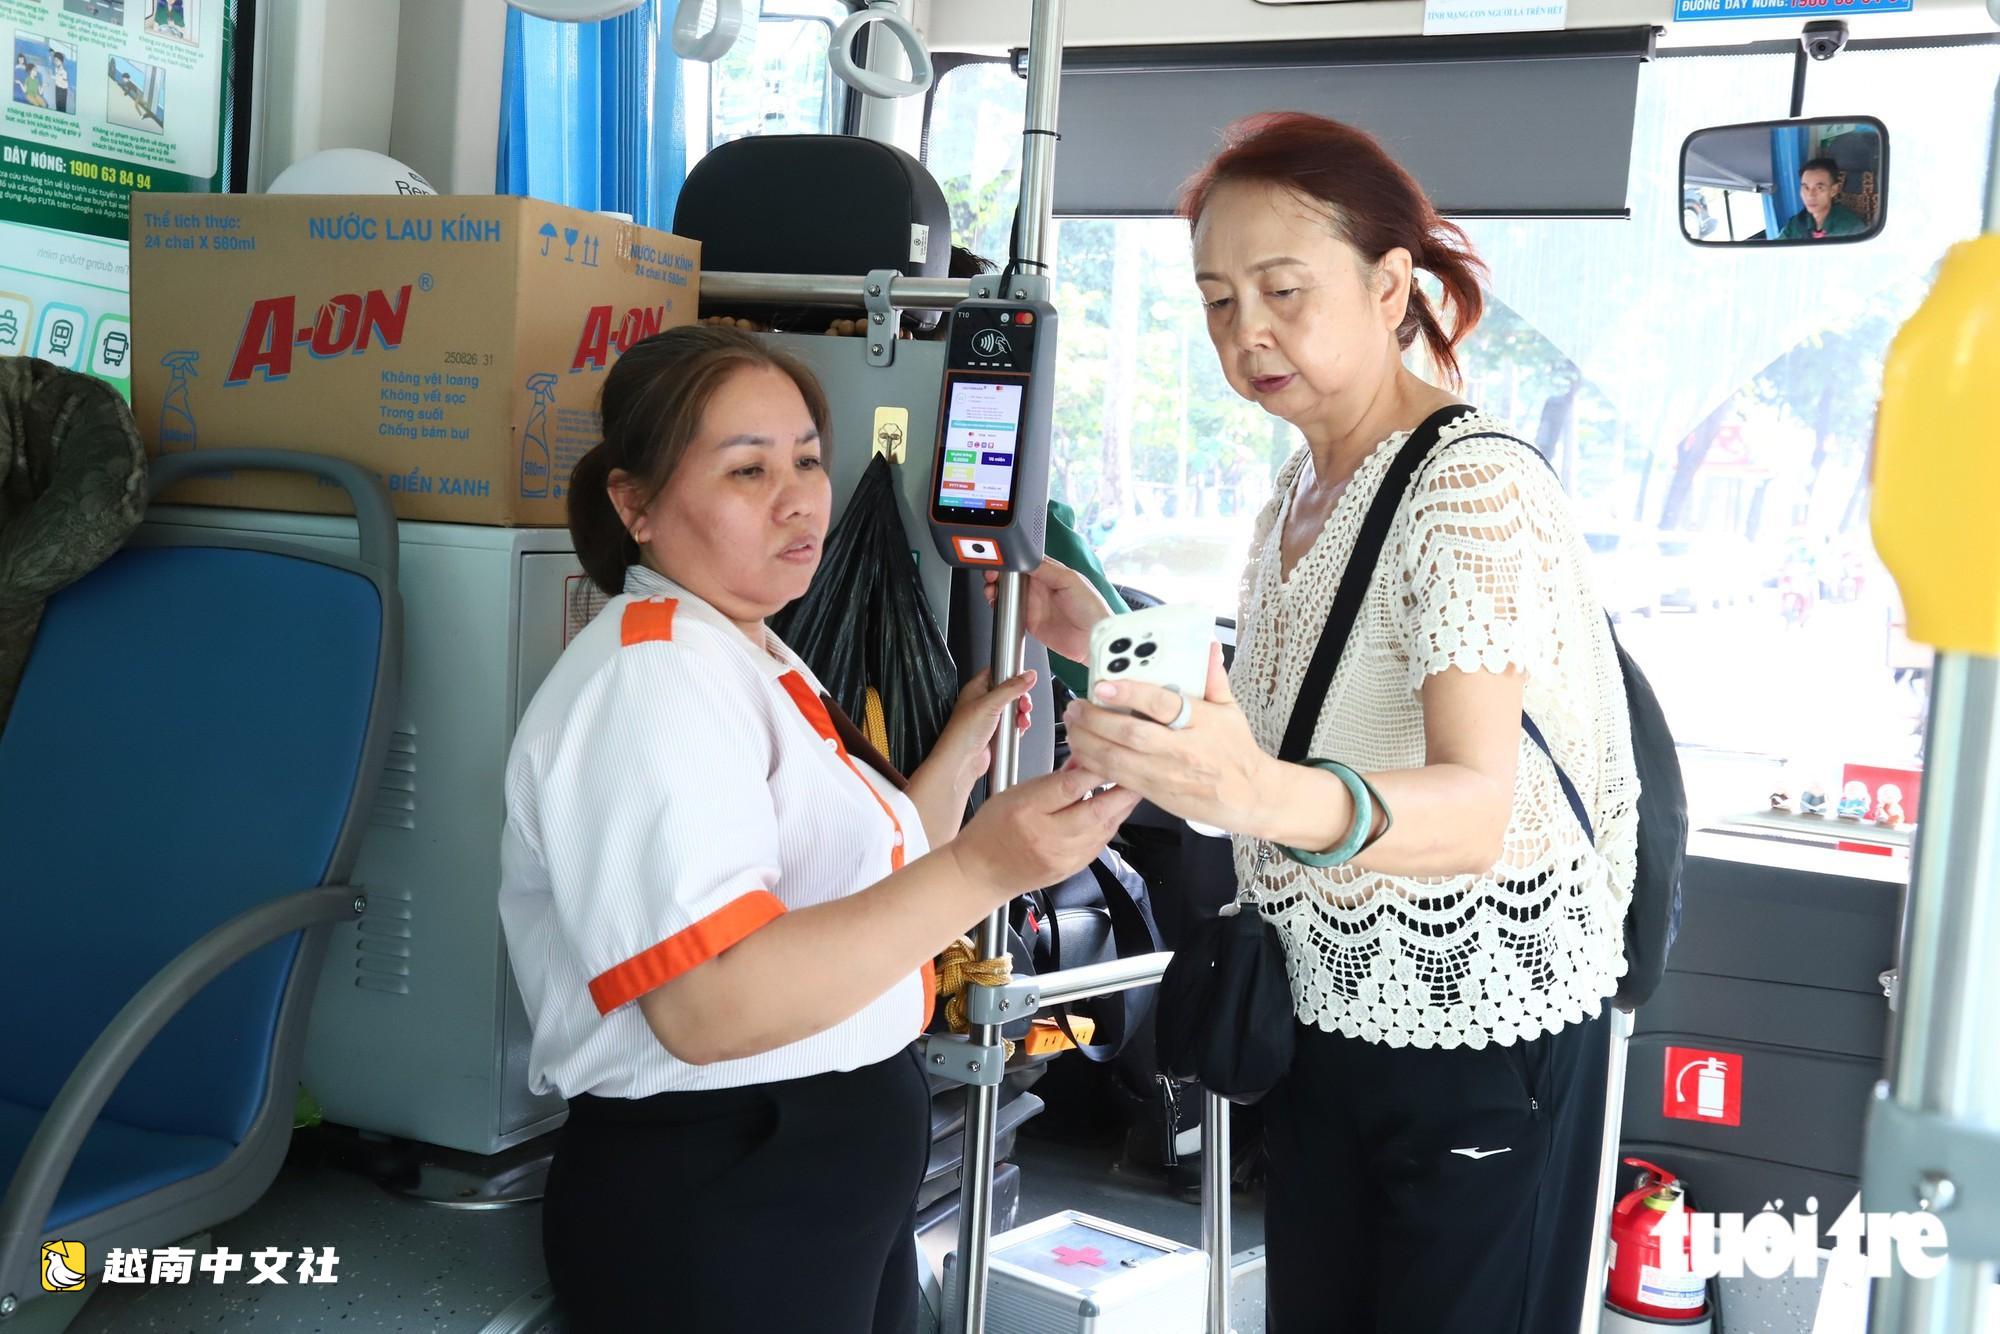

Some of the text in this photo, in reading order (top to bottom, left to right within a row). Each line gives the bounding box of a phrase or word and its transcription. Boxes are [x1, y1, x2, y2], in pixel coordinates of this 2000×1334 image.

[3, 145, 151, 190] DÂY NÓNG: 1900 63 84 94
[38, 197, 55, 207] FUTA
[72, 203, 93, 215] Google
[144, 209, 170, 229] Thể
[308, 211, 501, 242] NƯỚC LAU KÍNH
[144, 235, 161, 249] 24
[165, 235, 194, 249] chai
[658, 250, 673, 268] LAU
[957, 311, 970, 319] T10
[223, 284, 414, 389] A-ON
[444, 351, 494, 366] 250826 31
[381, 369, 420, 386] Không
[446, 373, 480, 389] loang
[381, 388, 419, 405] Không
[379, 405, 444, 422] Trong suốt
[378, 422, 417, 440] Chống
[439, 477, 490, 497] XANH
